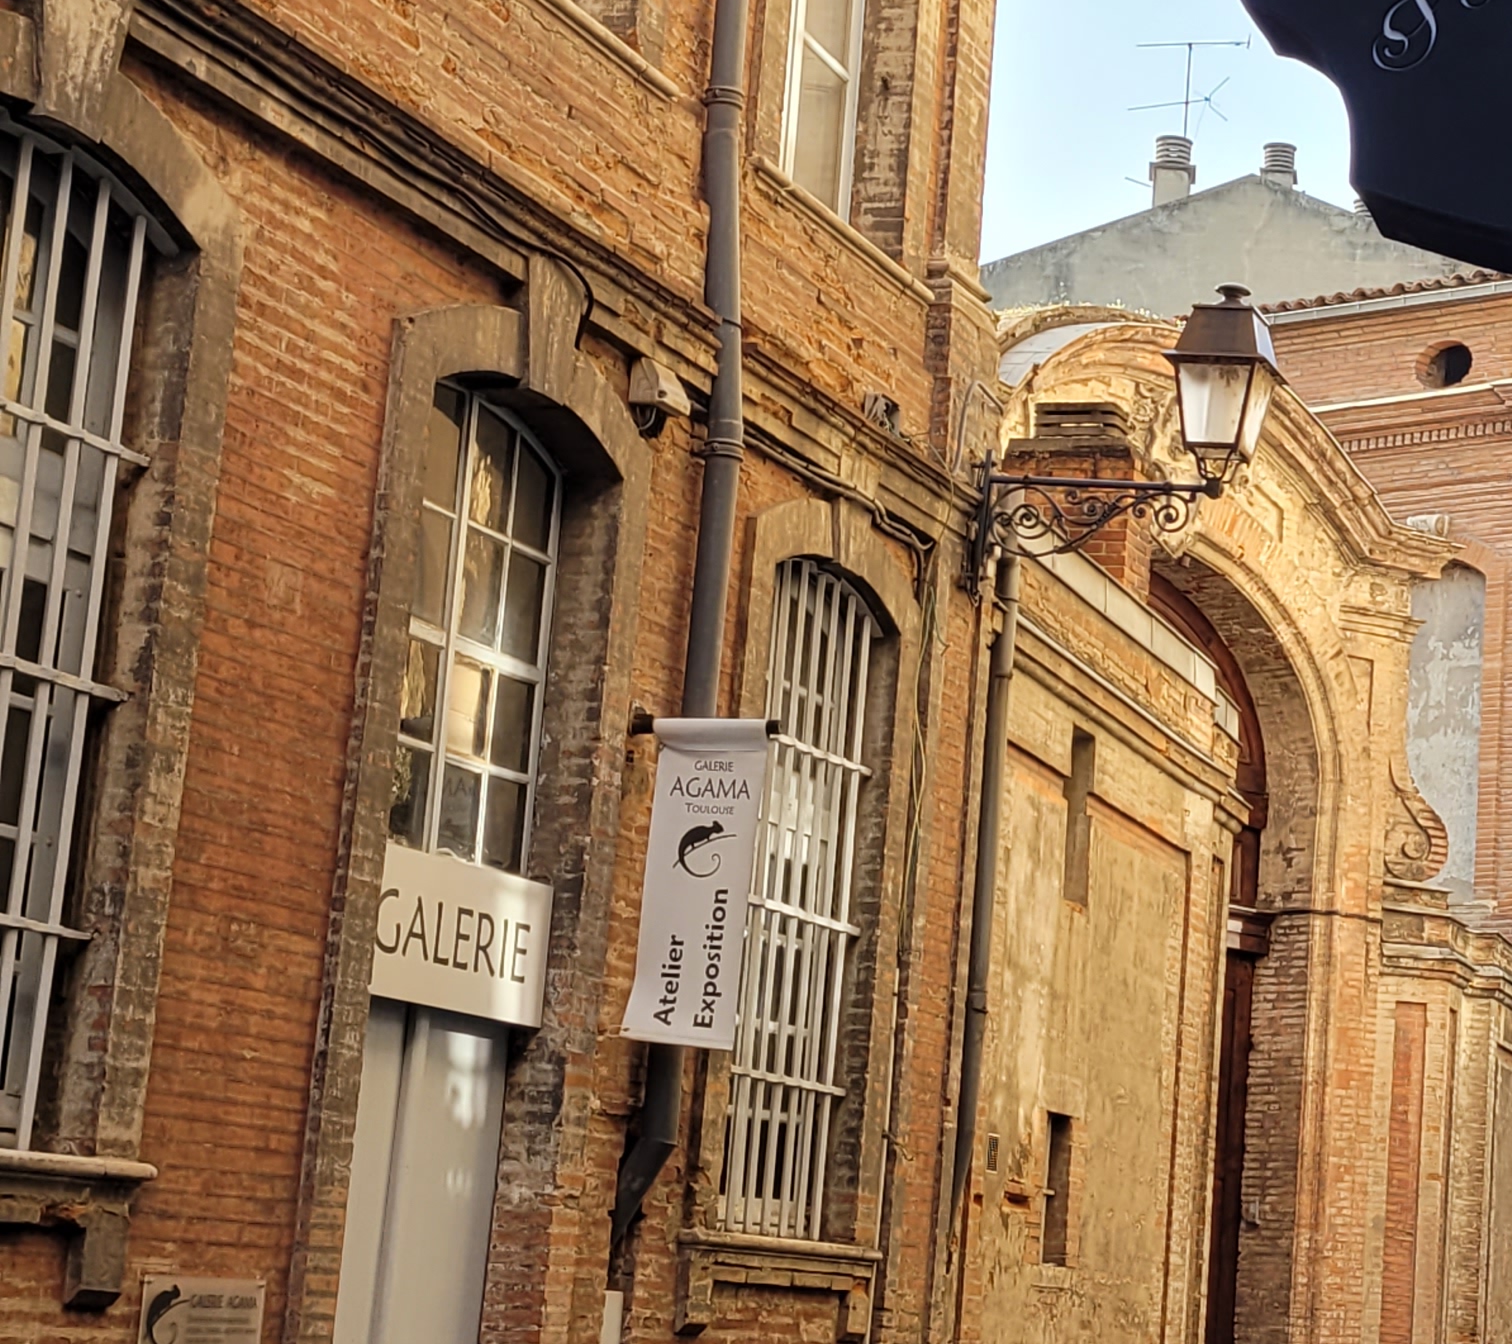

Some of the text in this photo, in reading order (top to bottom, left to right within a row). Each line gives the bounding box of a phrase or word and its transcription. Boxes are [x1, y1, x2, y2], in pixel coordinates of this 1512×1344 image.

[669, 775, 751, 800] AGAMA
[694, 759, 734, 773] GALERIE
[375, 887, 531, 984] GALERIE
[653, 934, 685, 1026] Atelier
[692, 888, 729, 1029] Exposition
